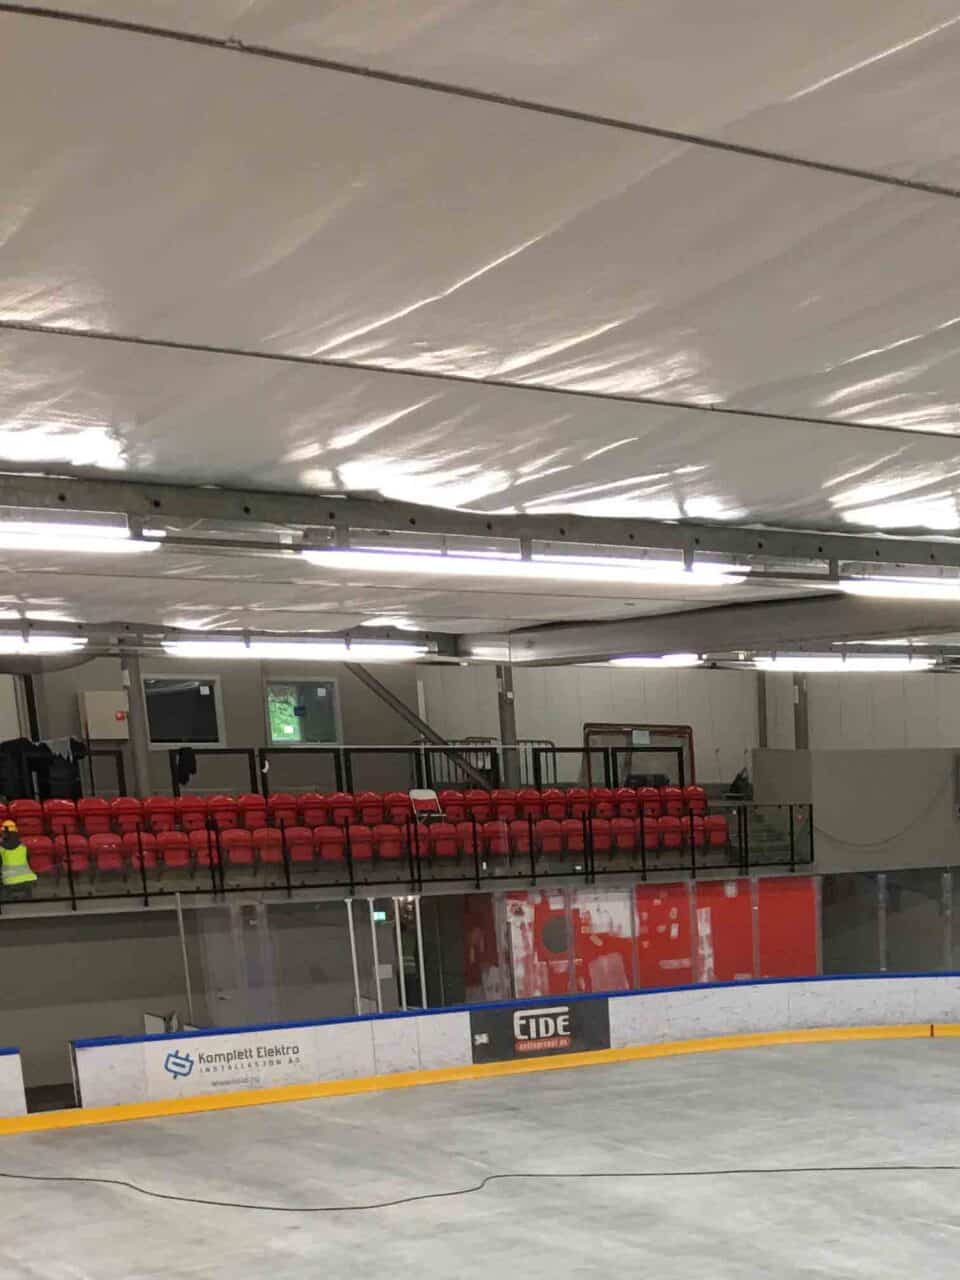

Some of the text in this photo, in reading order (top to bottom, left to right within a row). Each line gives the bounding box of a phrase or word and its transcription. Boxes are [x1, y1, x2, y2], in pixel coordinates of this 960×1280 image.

[513, 1006, 571, 1040] EIDE
[198, 1044, 300, 1064] Komplett Elektro
